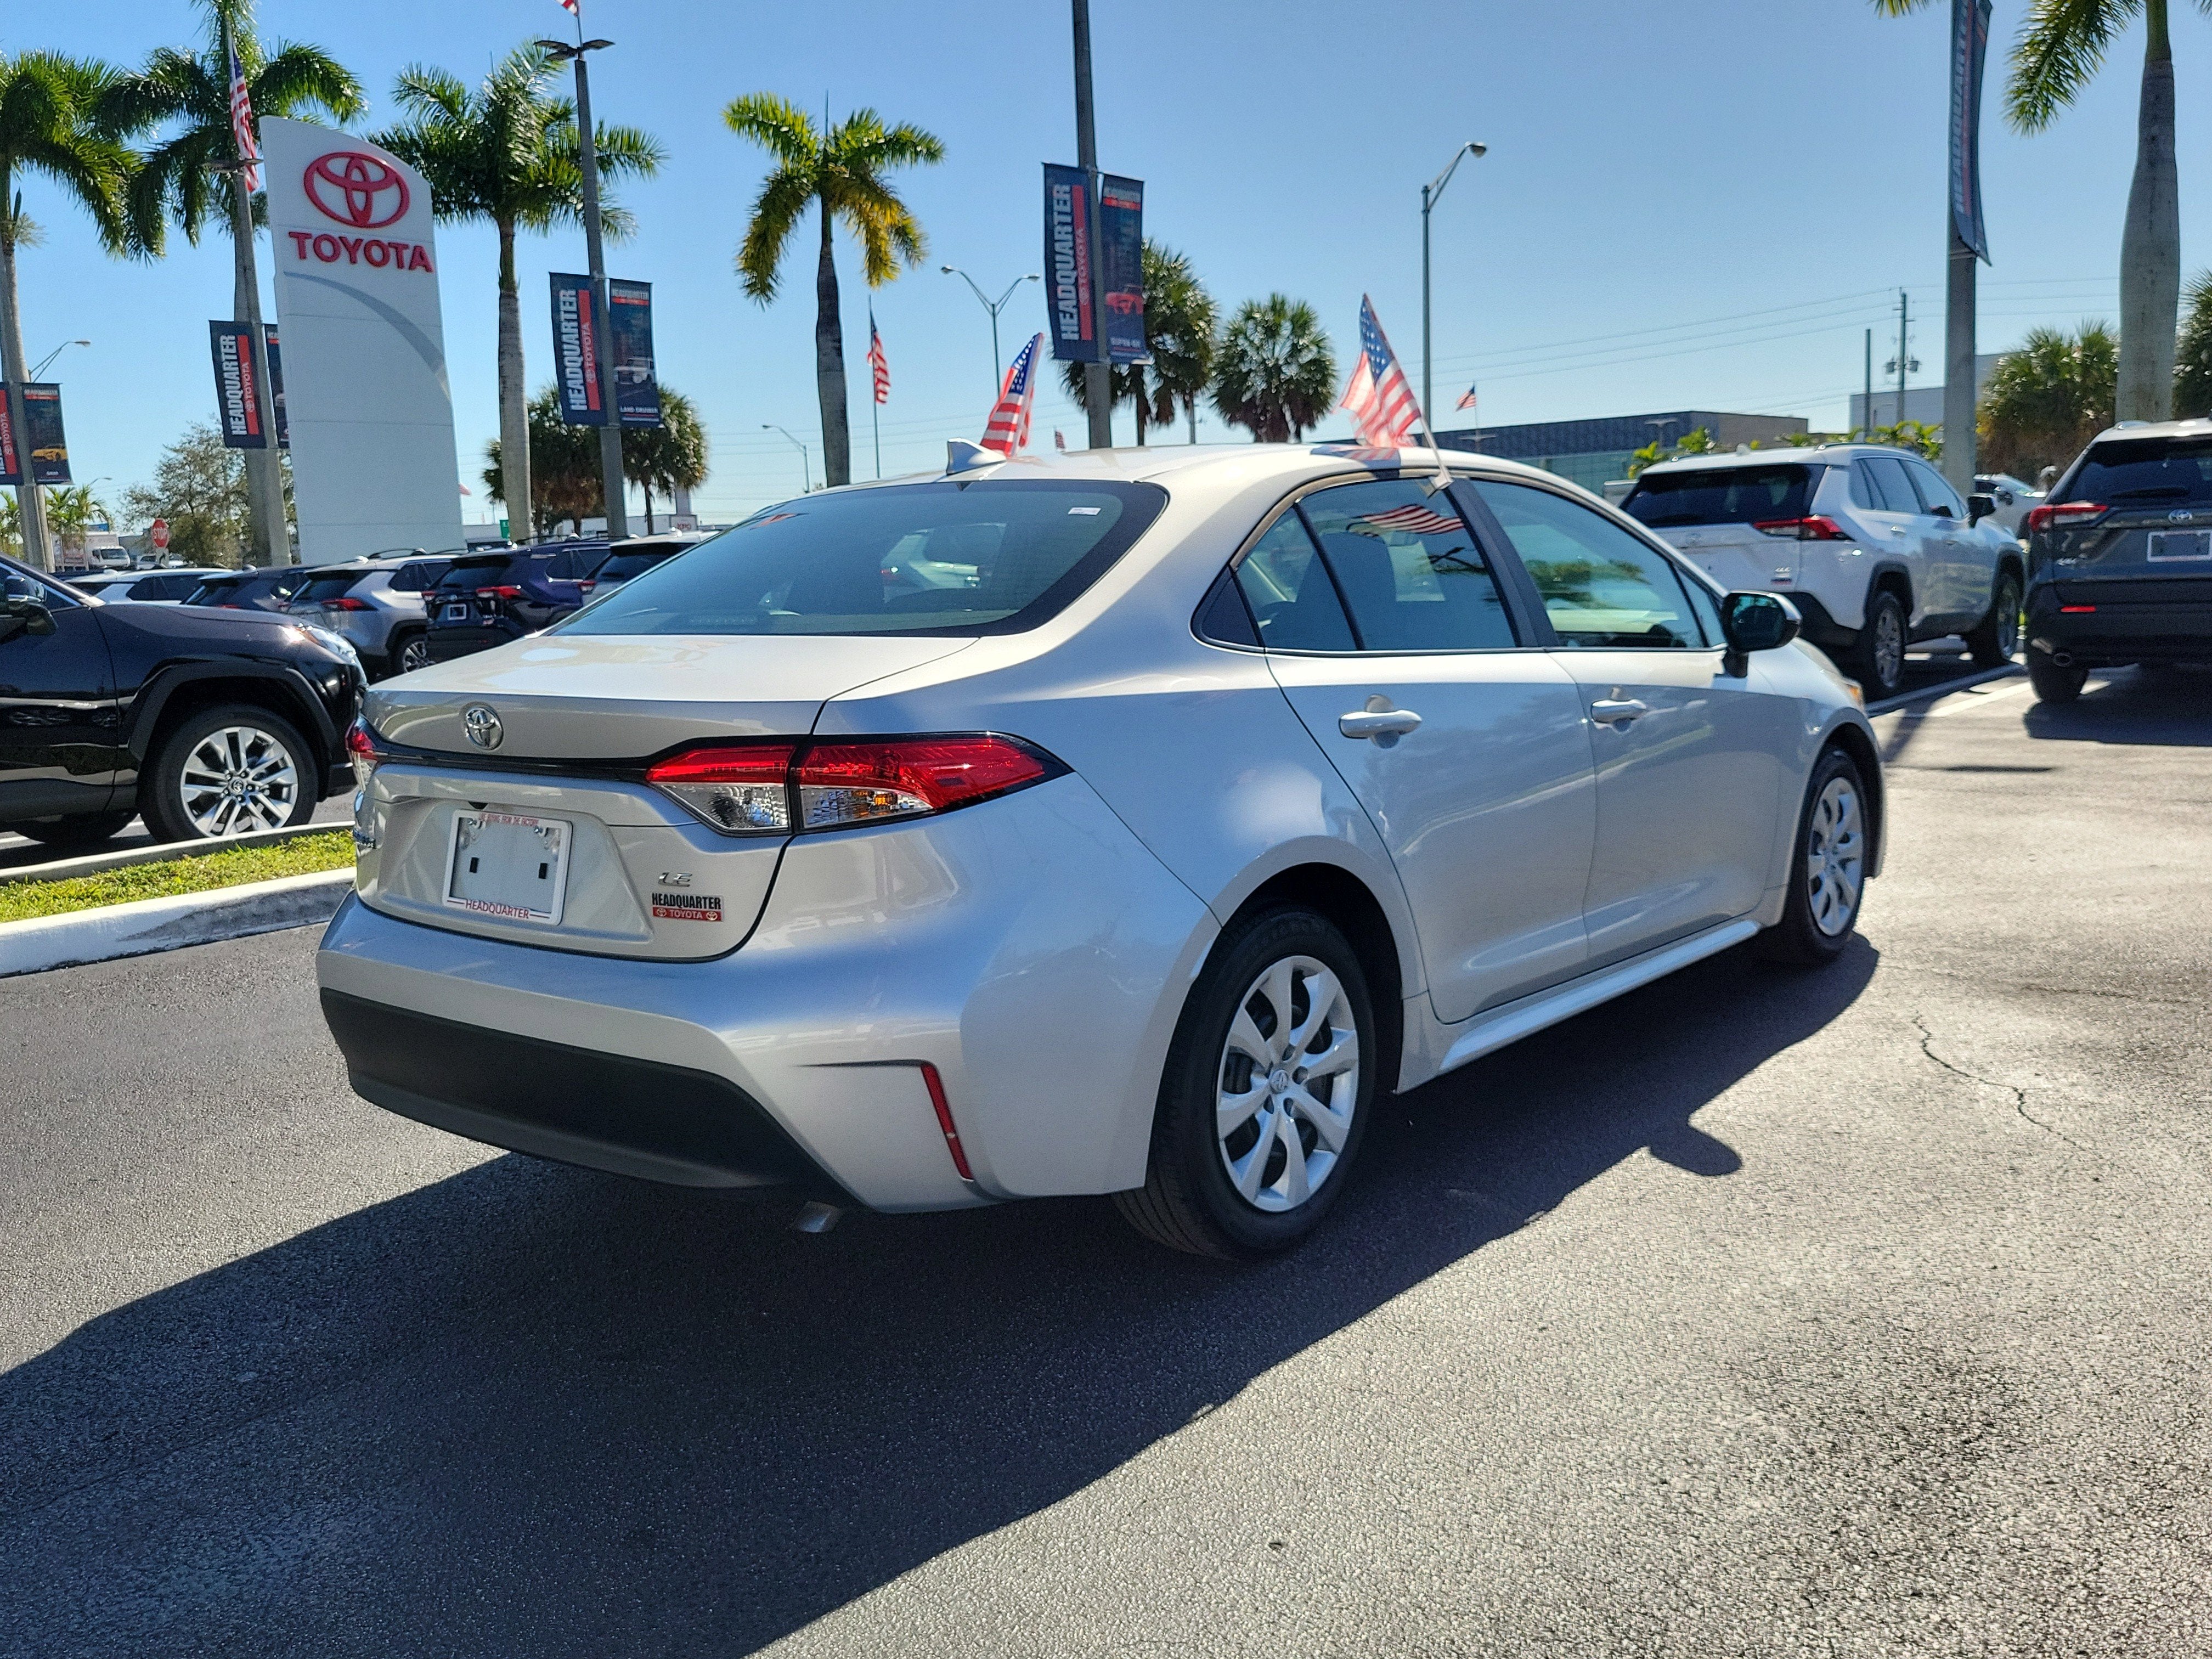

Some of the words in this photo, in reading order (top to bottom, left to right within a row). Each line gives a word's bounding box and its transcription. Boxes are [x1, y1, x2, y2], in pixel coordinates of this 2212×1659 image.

[289, 232, 433, 273] TOYOTA
[1053, 184, 1079, 341] HEADQUARTER
[1076, 227, 1087, 284] TOYOTA
[559, 289, 588, 411] HEADQUARTER
[582, 323, 594, 368] TOYOTA
[220, 335, 247, 436] HEADQUARTER
[241, 362, 253, 400] TOYOTA
[1, 413, 11, 444] TOYOTA
[154, 527, 168, 539] STOP
[658, 872, 692, 887] LE
[466, 899, 529, 918] HEADQUARTER
[652, 893, 721, 910] HEADQUARTER
[670, 910, 703, 919] TOYOTA
